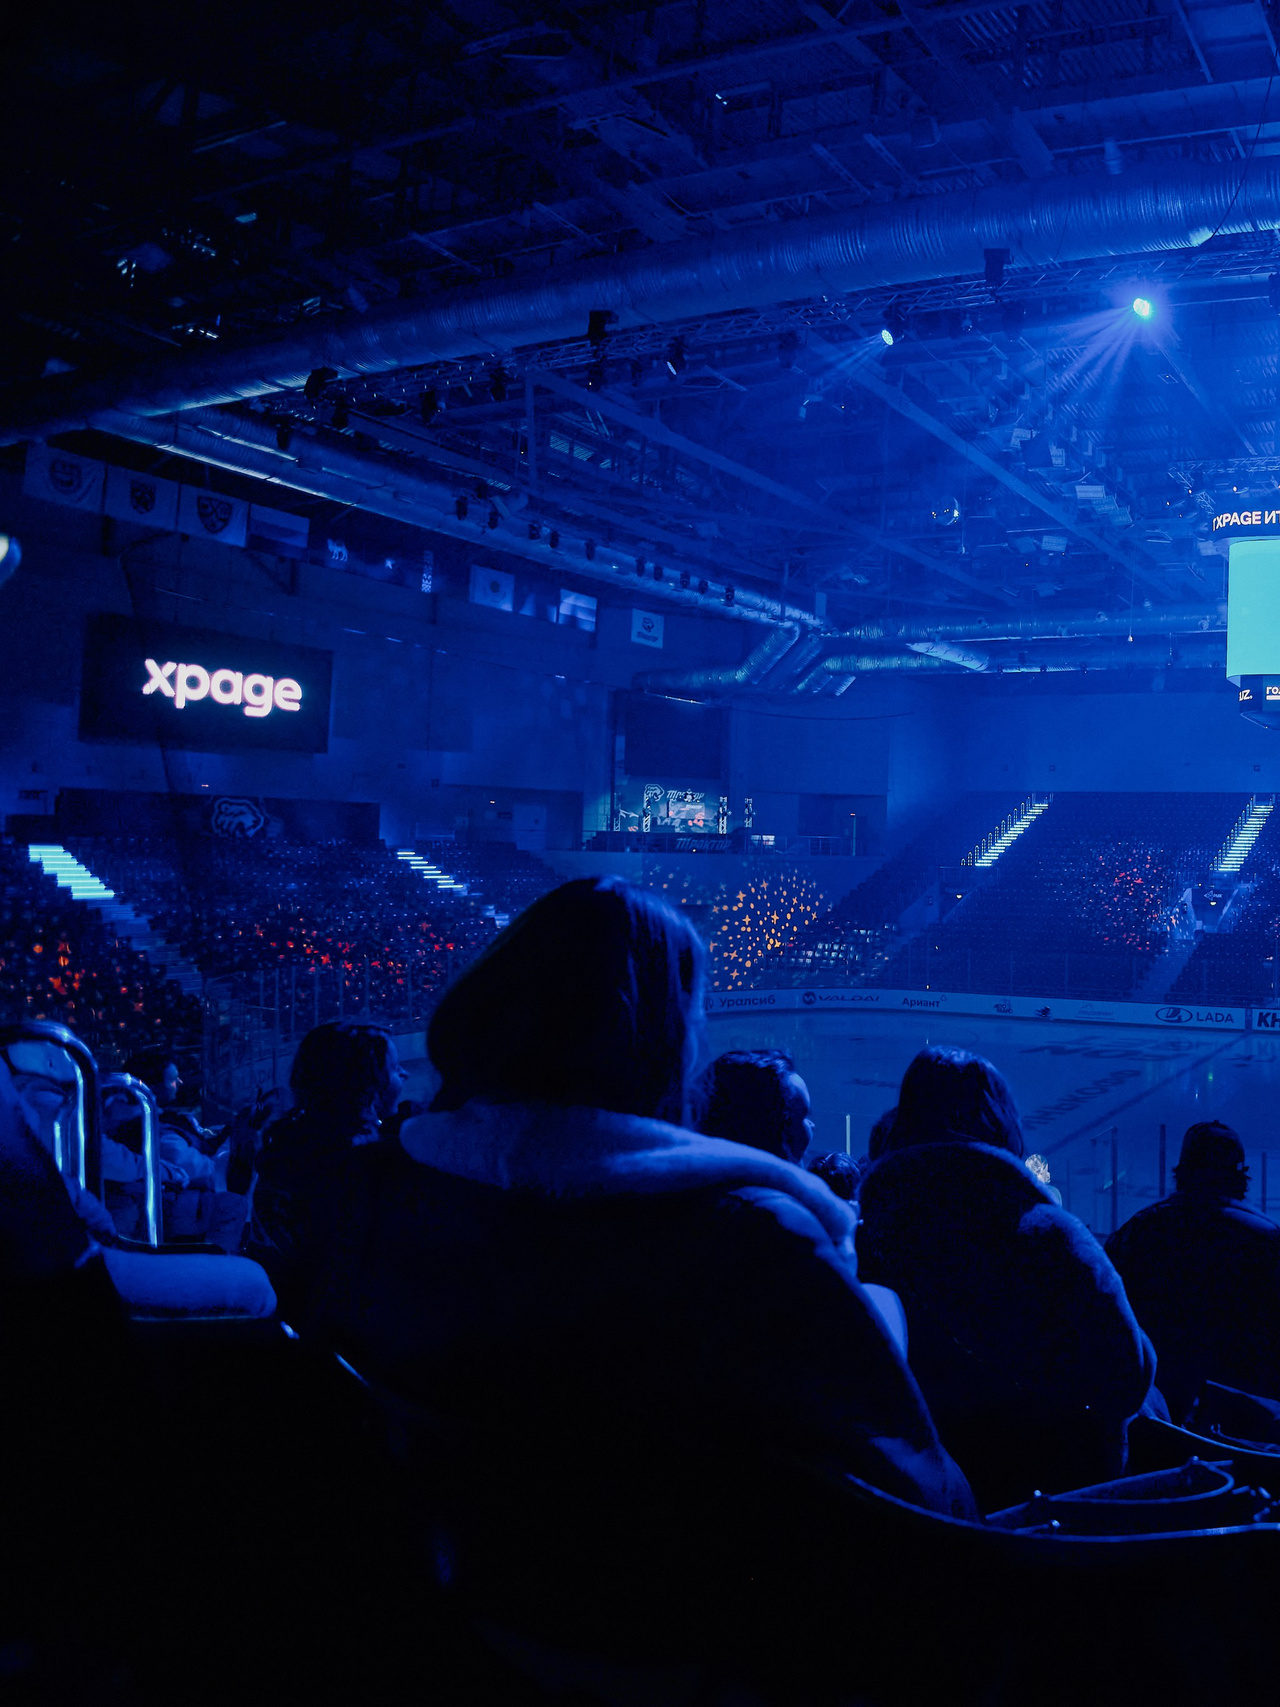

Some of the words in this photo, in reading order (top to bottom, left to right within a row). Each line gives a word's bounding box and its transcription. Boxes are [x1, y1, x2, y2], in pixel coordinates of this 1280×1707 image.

[1216, 511, 1262, 530] XPAGE
[142, 658, 303, 718] xpage
[719, 994, 776, 1008] Уралсиб
[902, 997, 941, 1008] Ариант
[1196, 1011, 1235, 1024] LADA
